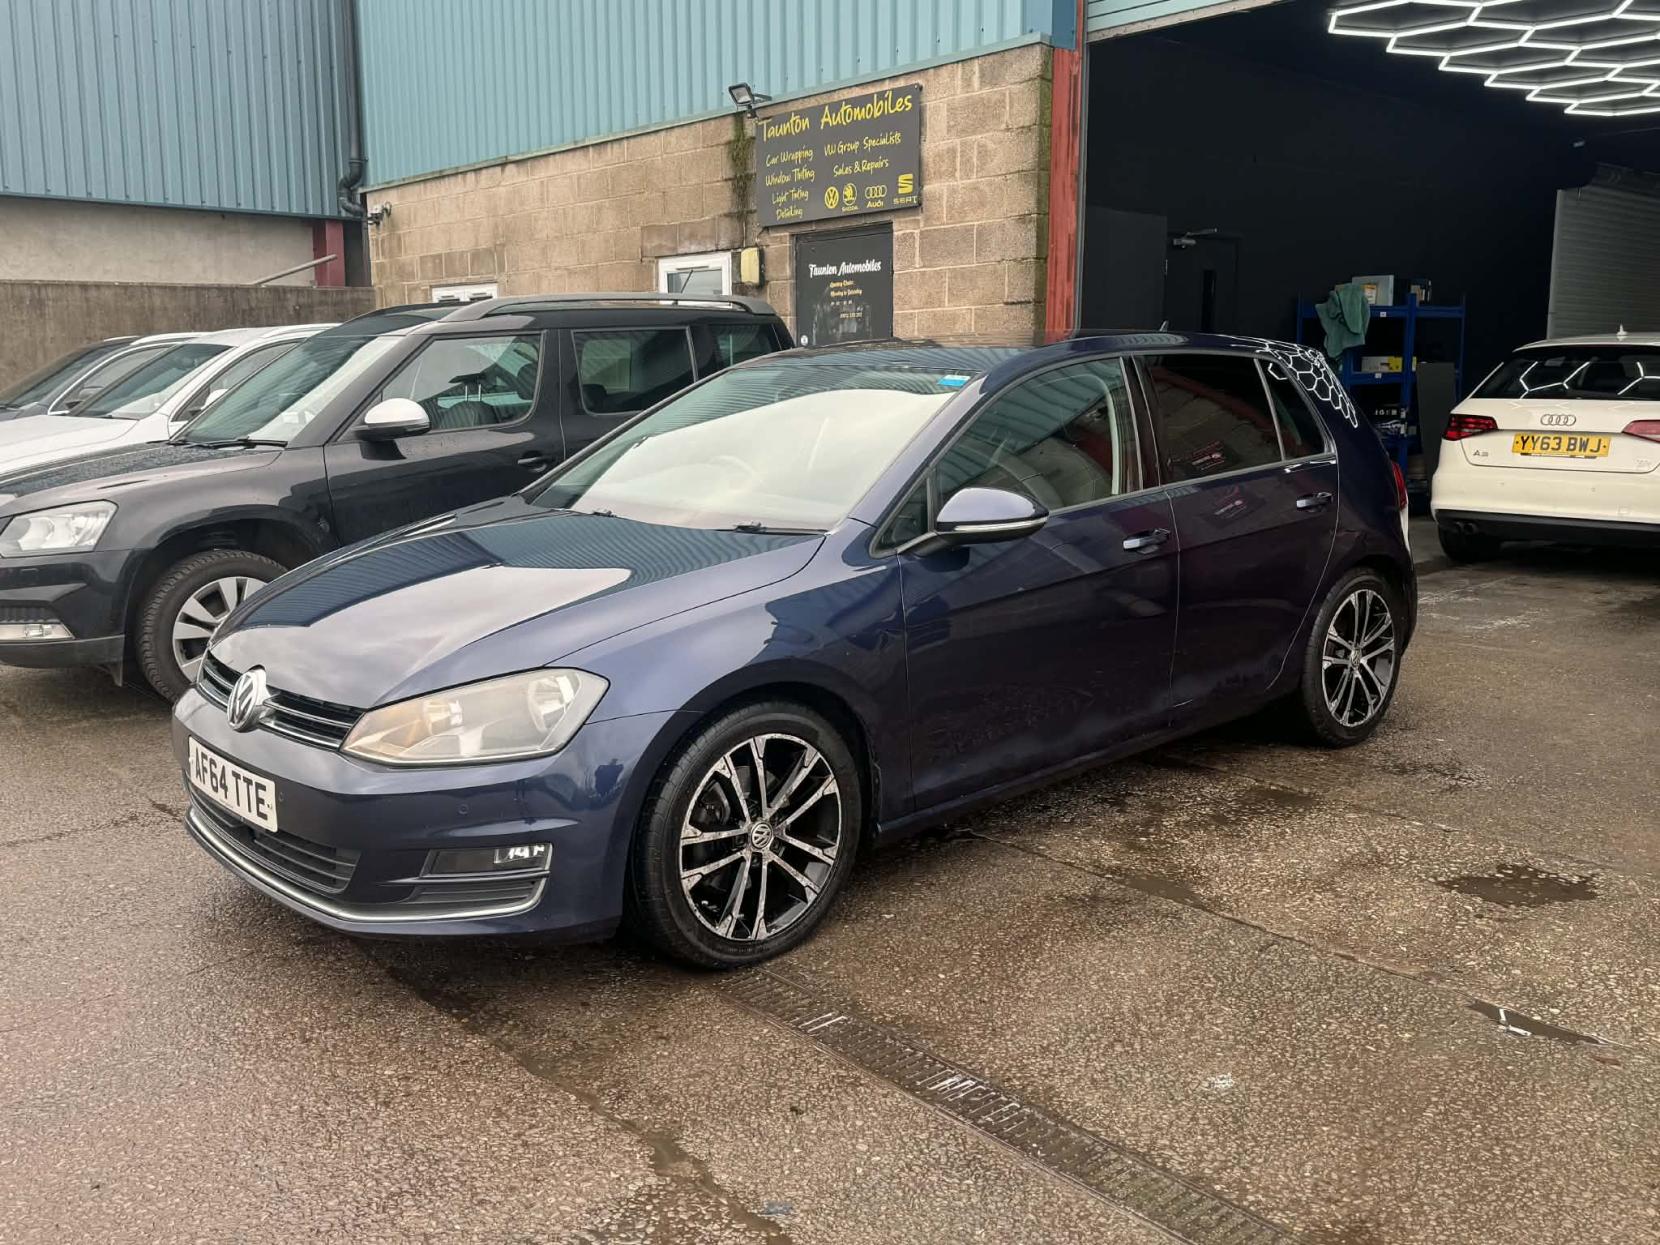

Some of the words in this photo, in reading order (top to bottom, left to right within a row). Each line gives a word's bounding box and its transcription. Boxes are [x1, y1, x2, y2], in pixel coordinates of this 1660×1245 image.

[758, 112, 810, 142] Taunton
[820, 90, 912, 130] Automobiles
[837, 140, 860, 155] Group
[863, 131, 902, 152] Specialists
[765, 154, 779, 167] Car
[780, 145, 813, 165] Wrapping
[833, 162, 853, 177] Sales
[862, 156, 889, 175] Repairs
[765, 171, 791, 186] Window
[772, 191, 789, 207] Light
[866, 199, 884, 208] Audi
[893, 195, 918, 205] SEAT
[776, 205, 803, 220] Detailing
[808, 263, 837, 278] Taunton
[838, 259, 882, 276] Automobiles
[1520, 436, 1562, 451] YY63
[1565, 437, 1602, 453] BWJ
[195, 746, 229, 800] AF64
[231, 770, 269, 822] TTE
